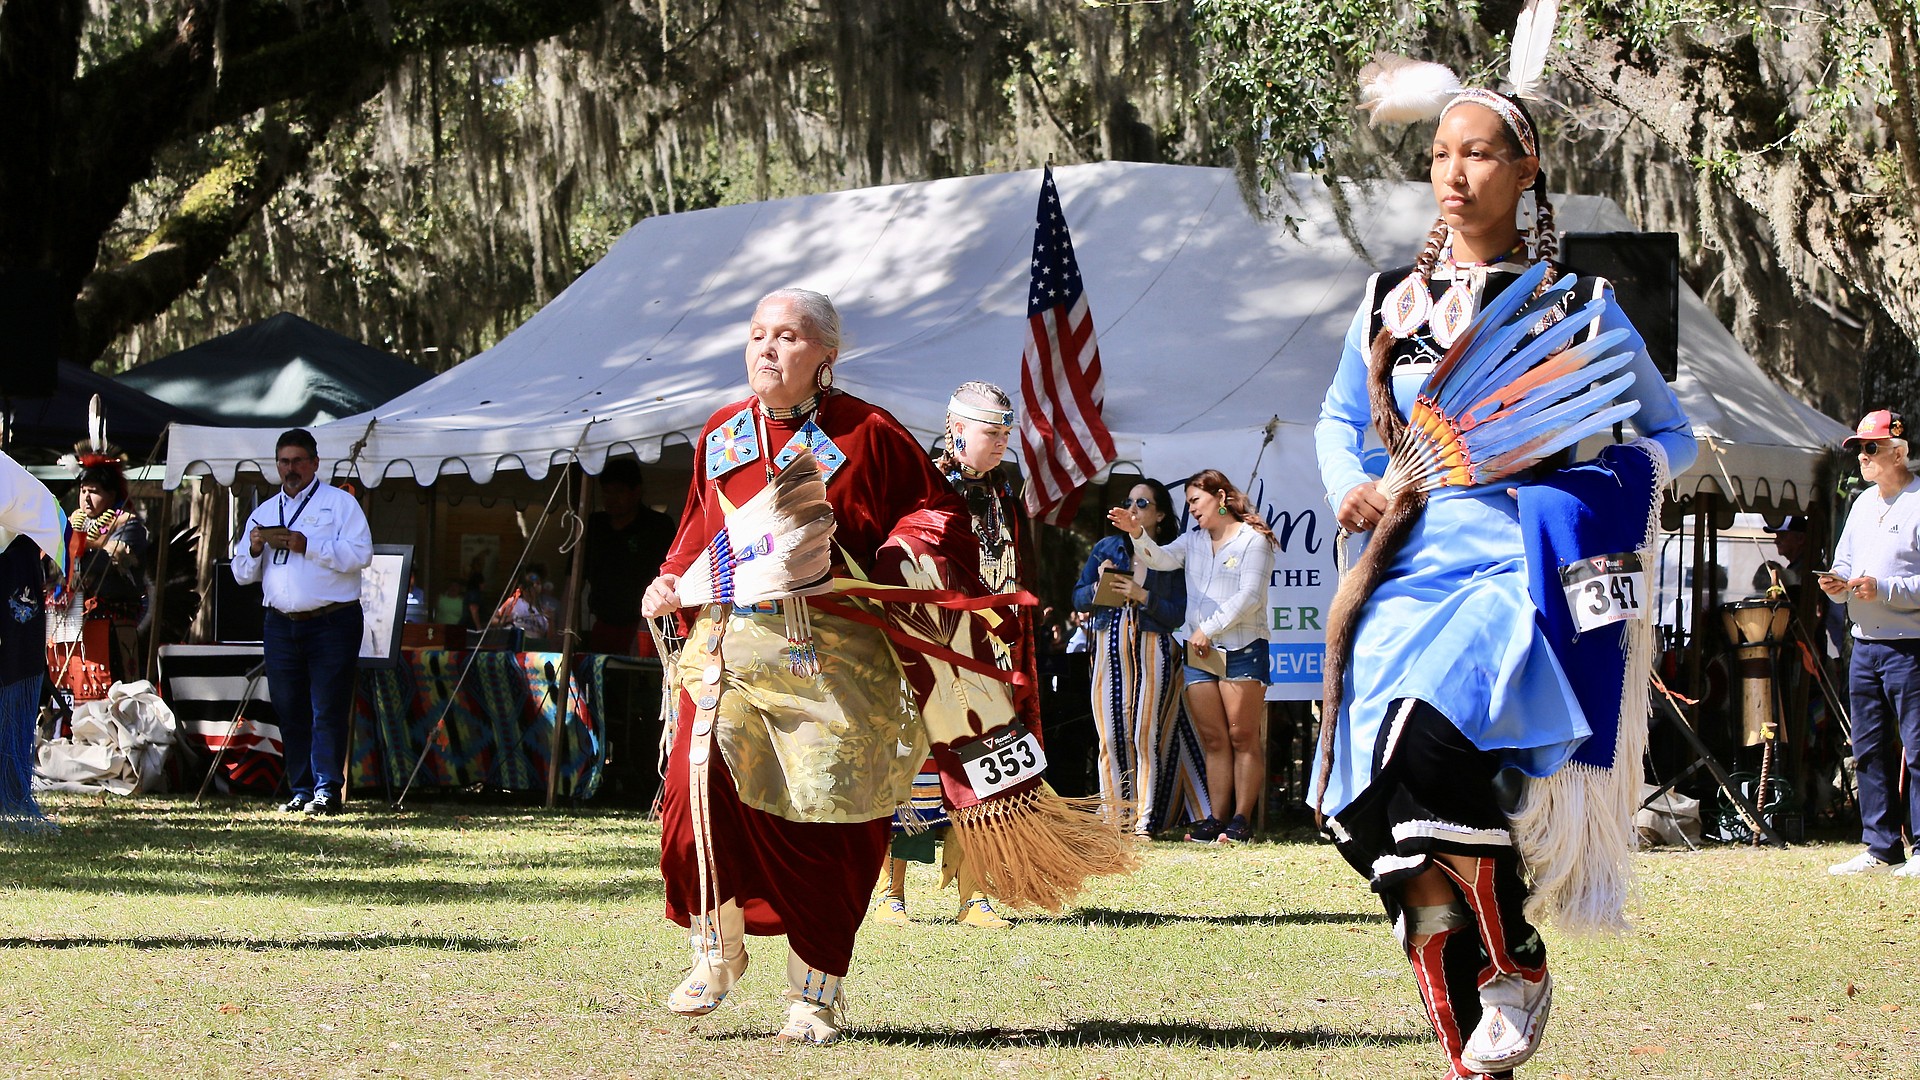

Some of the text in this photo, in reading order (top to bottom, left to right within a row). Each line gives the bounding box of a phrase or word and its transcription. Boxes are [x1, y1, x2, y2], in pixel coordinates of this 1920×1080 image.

[1584, 576, 1639, 615] 347
[1271, 607, 1322, 631] ER
[979, 740, 1036, 785] 353
